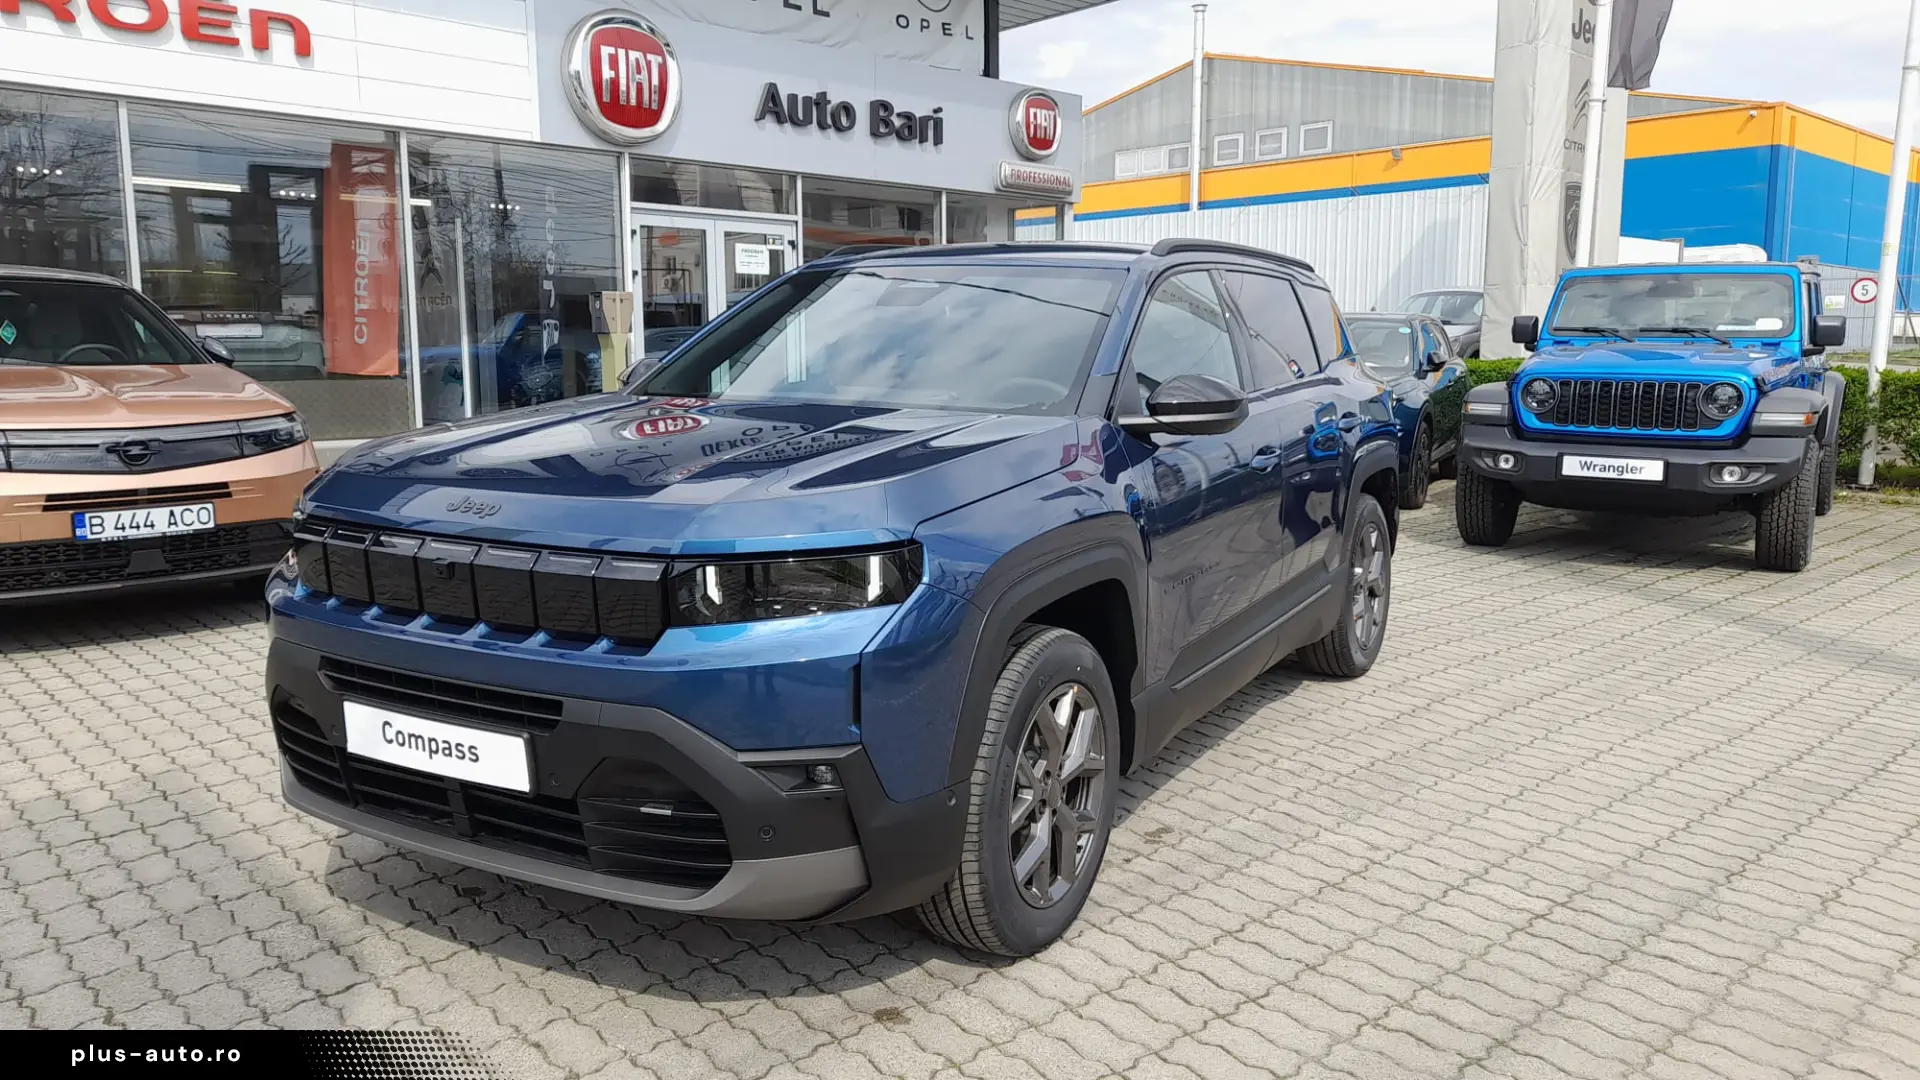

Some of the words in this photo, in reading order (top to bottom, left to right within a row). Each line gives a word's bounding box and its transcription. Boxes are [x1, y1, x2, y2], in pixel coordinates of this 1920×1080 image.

[896, 14, 974, 40] OPEL
[600, 45, 663, 110] FIAT
[754, 82, 856, 132] Auto
[870, 99, 943, 146] Bari
[1029, 107, 1055, 140] FIAT
[1010, 168, 1072, 188] PROFESSIONAL
[1861, 284, 1869, 297] 5
[1578, 459, 1646, 476] Wrangler
[88, 515, 105, 535] B
[114, 511, 156, 532] 444
[167, 506, 211, 529] ACO
[446, 495, 502, 519] Jeep
[381, 720, 480, 763] Compass
